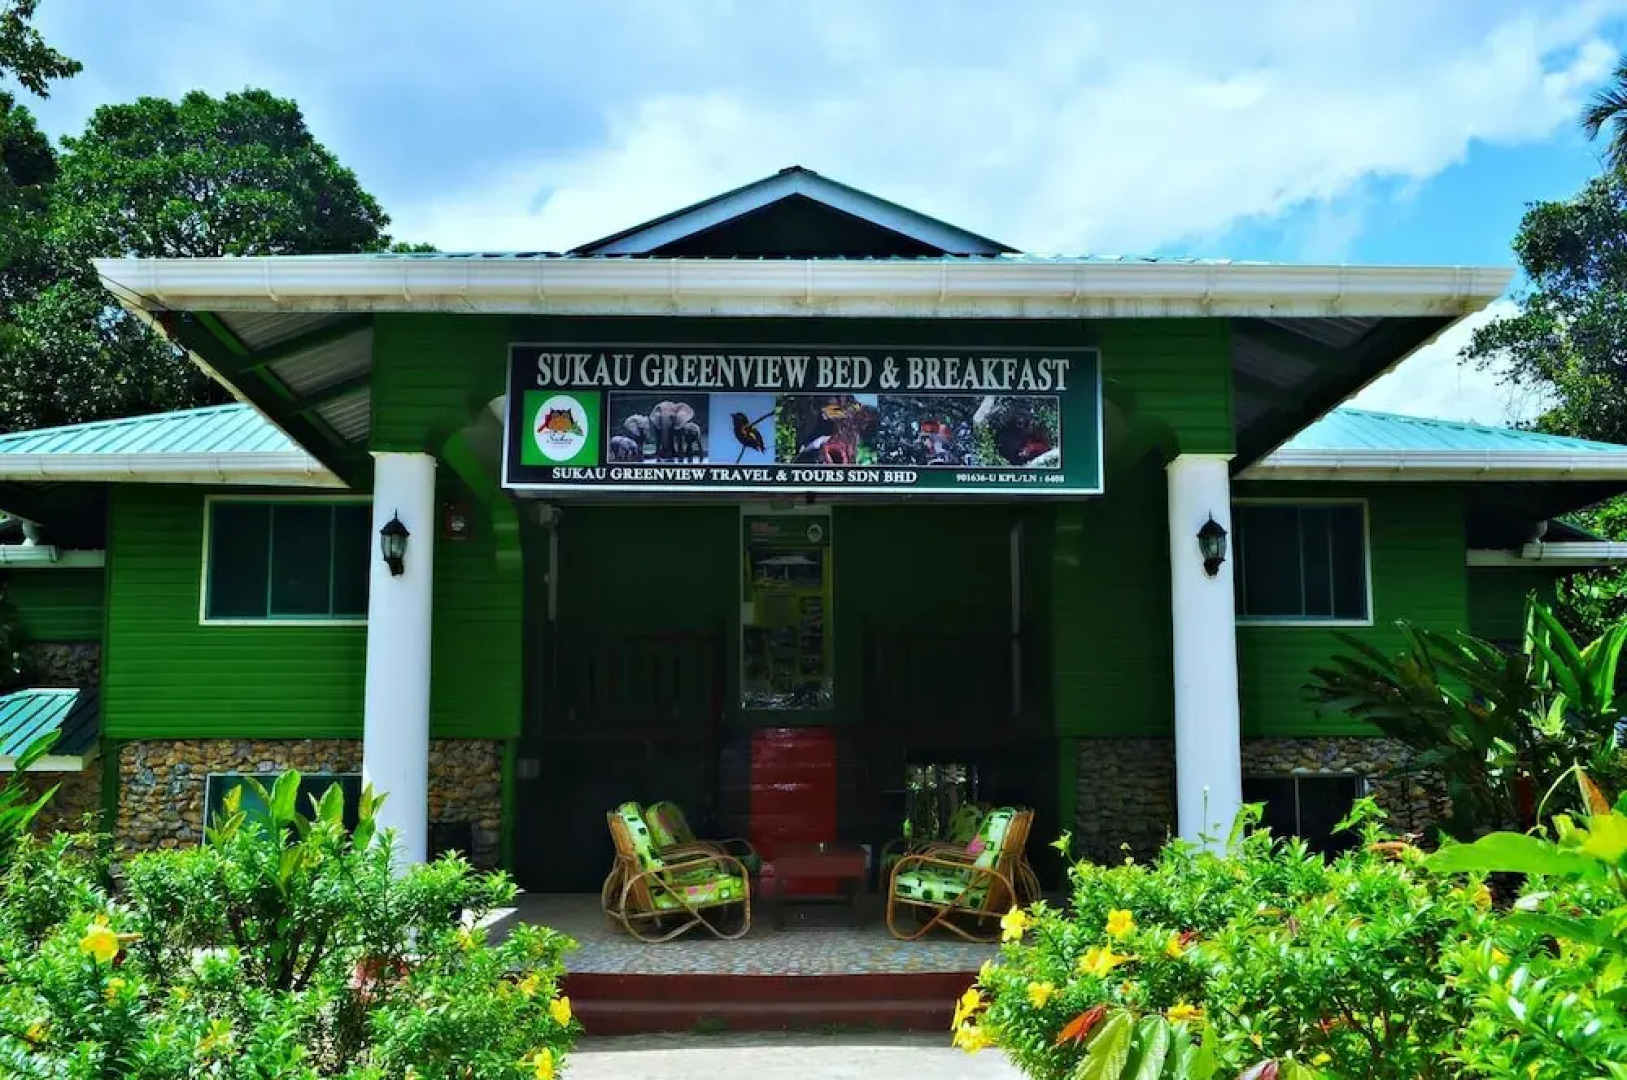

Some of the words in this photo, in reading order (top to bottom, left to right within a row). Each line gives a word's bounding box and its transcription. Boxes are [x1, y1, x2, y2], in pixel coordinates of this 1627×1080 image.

[537, 353, 633, 386] SUKAU
[640, 354, 810, 388] GREENVIEW
[816, 356, 872, 388] BED
[879, 356, 900, 388] &
[907, 358, 1069, 391] BREAKFAST
[552, 467, 606, 479] SUKAU
[610, 468, 706, 481] GREENVIEW
[710, 469, 772, 481] TRAVEL
[776, 470, 787, 481] &
[791, 470, 844, 482] TOURS
[848, 470, 879, 482] SDN
[883, 471, 917, 482] BHD
